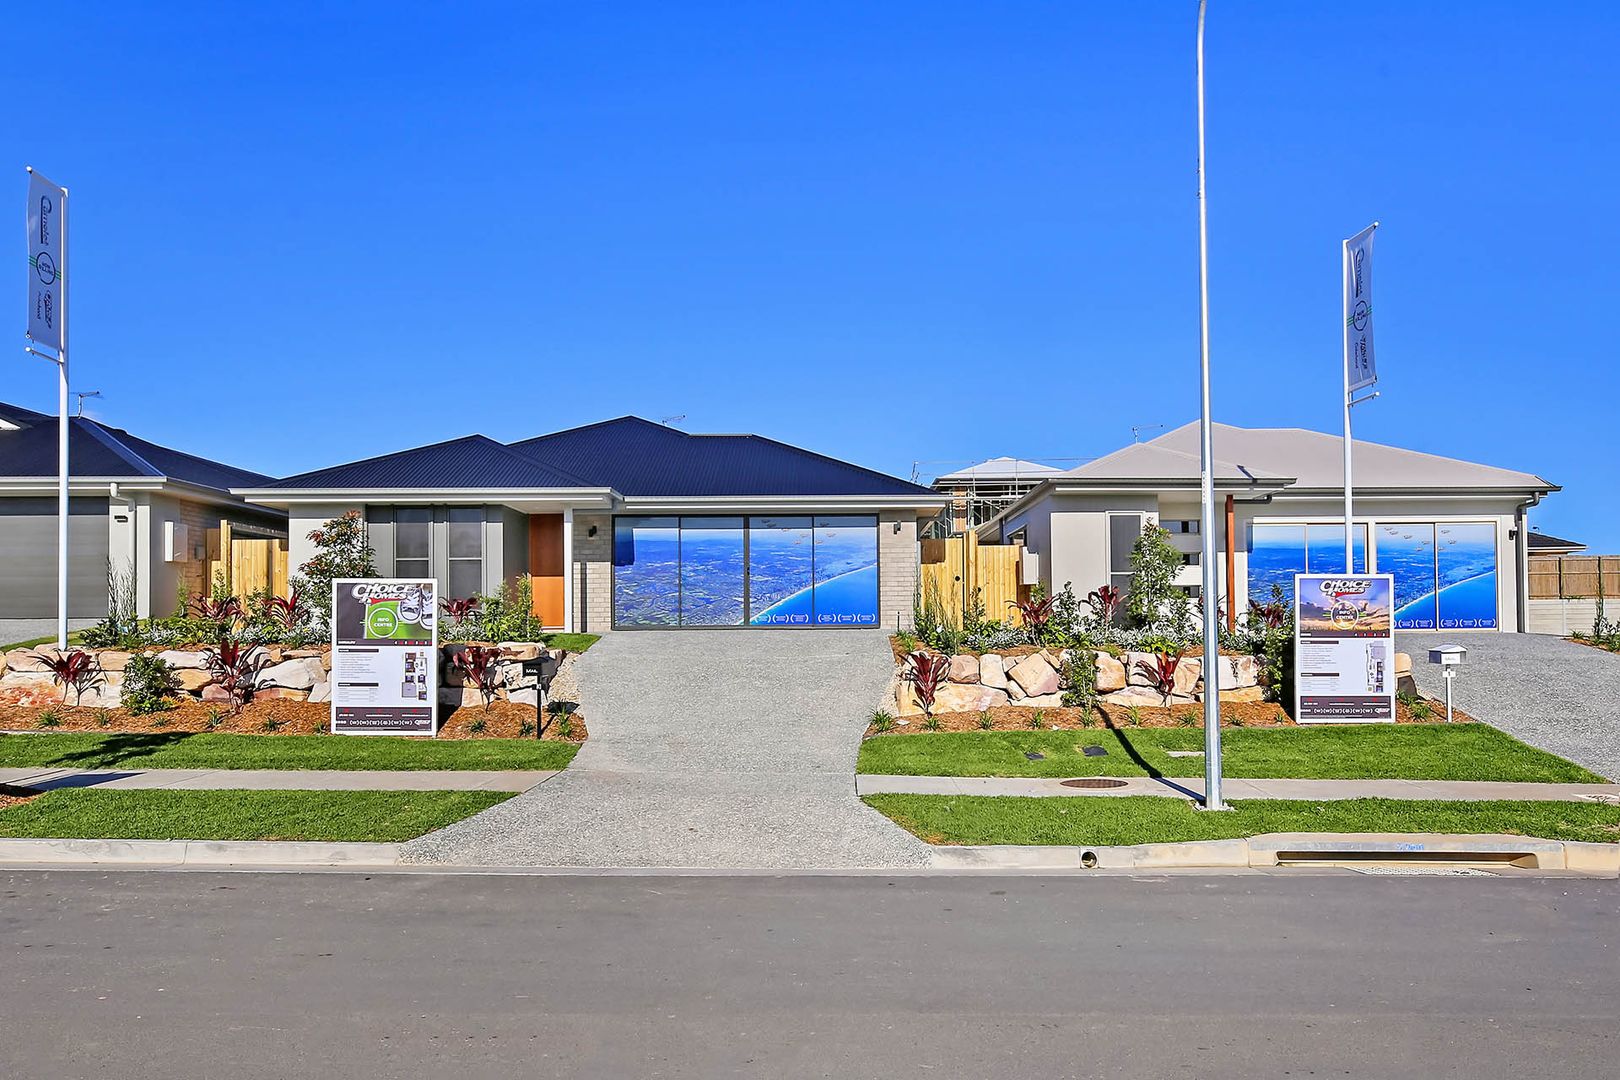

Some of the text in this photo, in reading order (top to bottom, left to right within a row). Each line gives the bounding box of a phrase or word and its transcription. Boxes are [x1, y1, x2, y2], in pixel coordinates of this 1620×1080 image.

[352, 583, 415, 599] CHOICE
[1320, 580, 1371, 592] CHOICE
[359, 592, 407, 603] HOMES
[1326, 588, 1365, 596] HOMES
